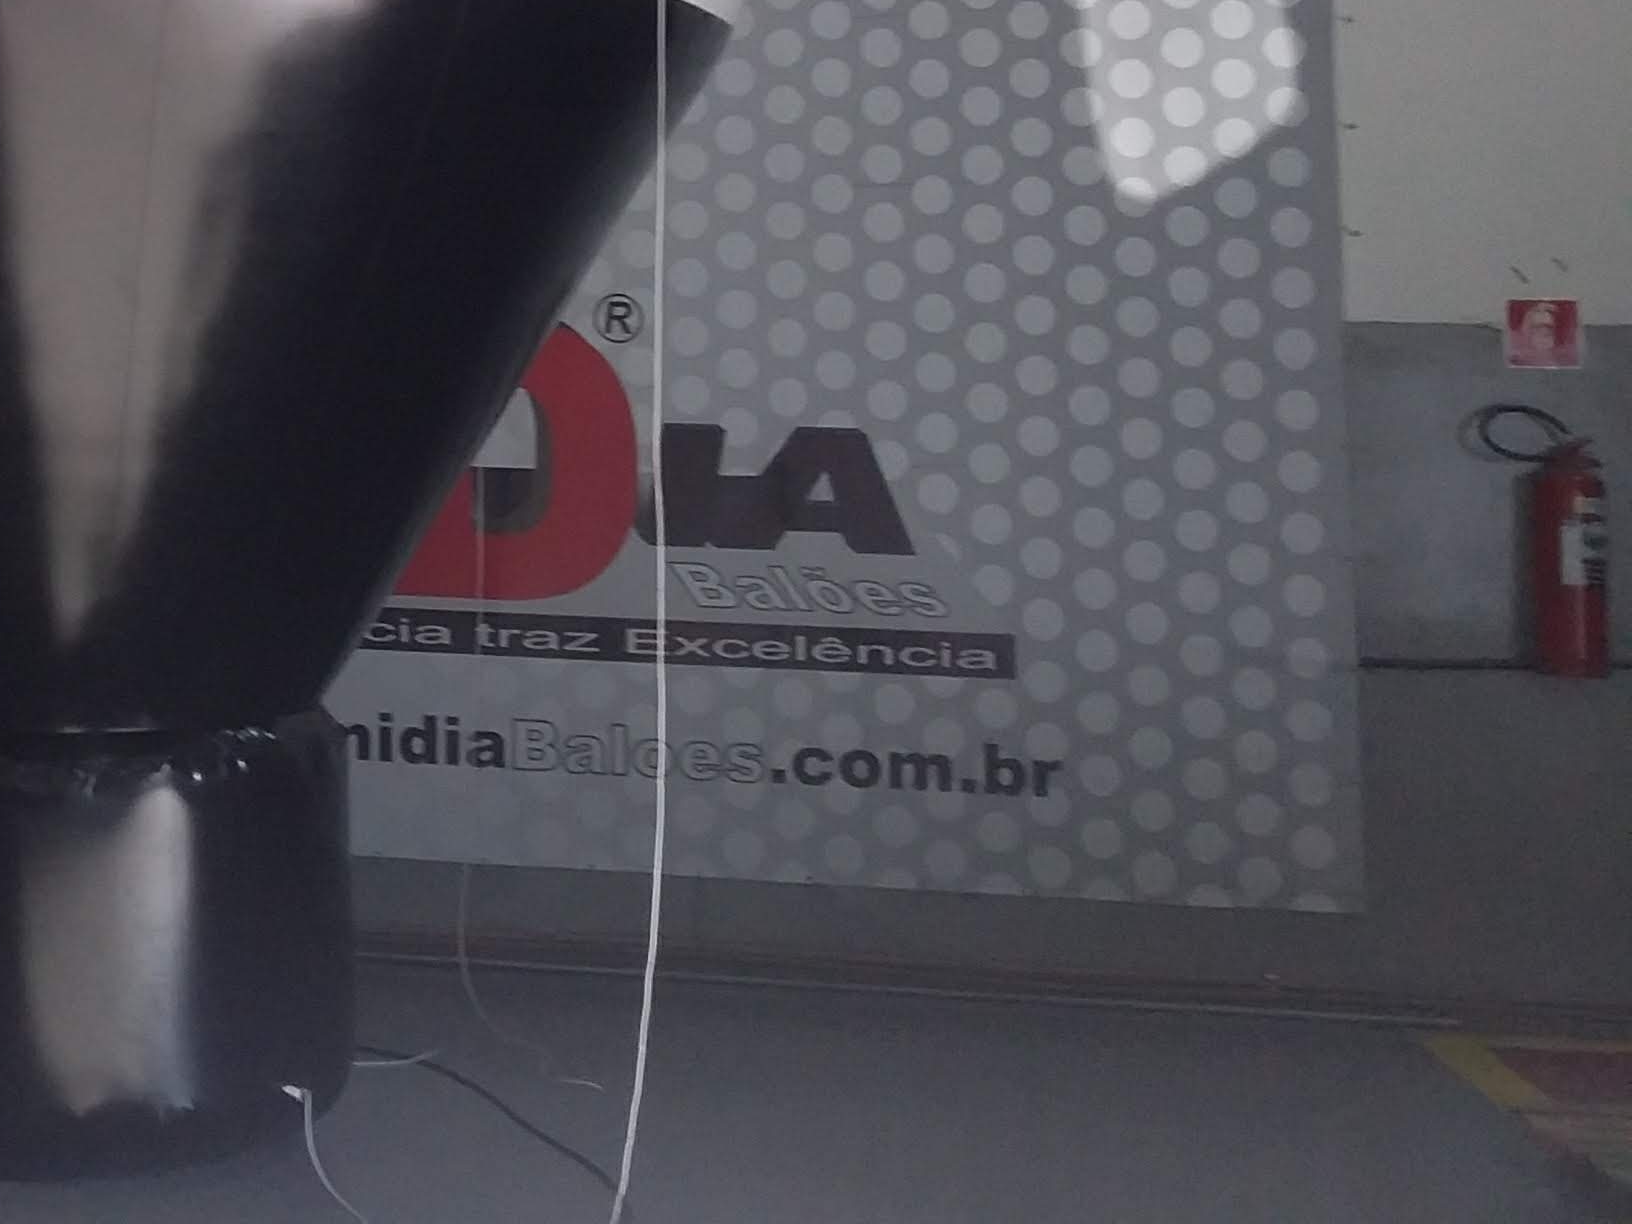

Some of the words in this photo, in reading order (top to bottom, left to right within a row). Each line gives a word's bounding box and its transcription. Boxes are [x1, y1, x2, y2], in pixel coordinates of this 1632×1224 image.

[668, 561, 949, 618] Balões
[474, 622, 601, 653] traz
[624, 627, 999, 671] Excelência
